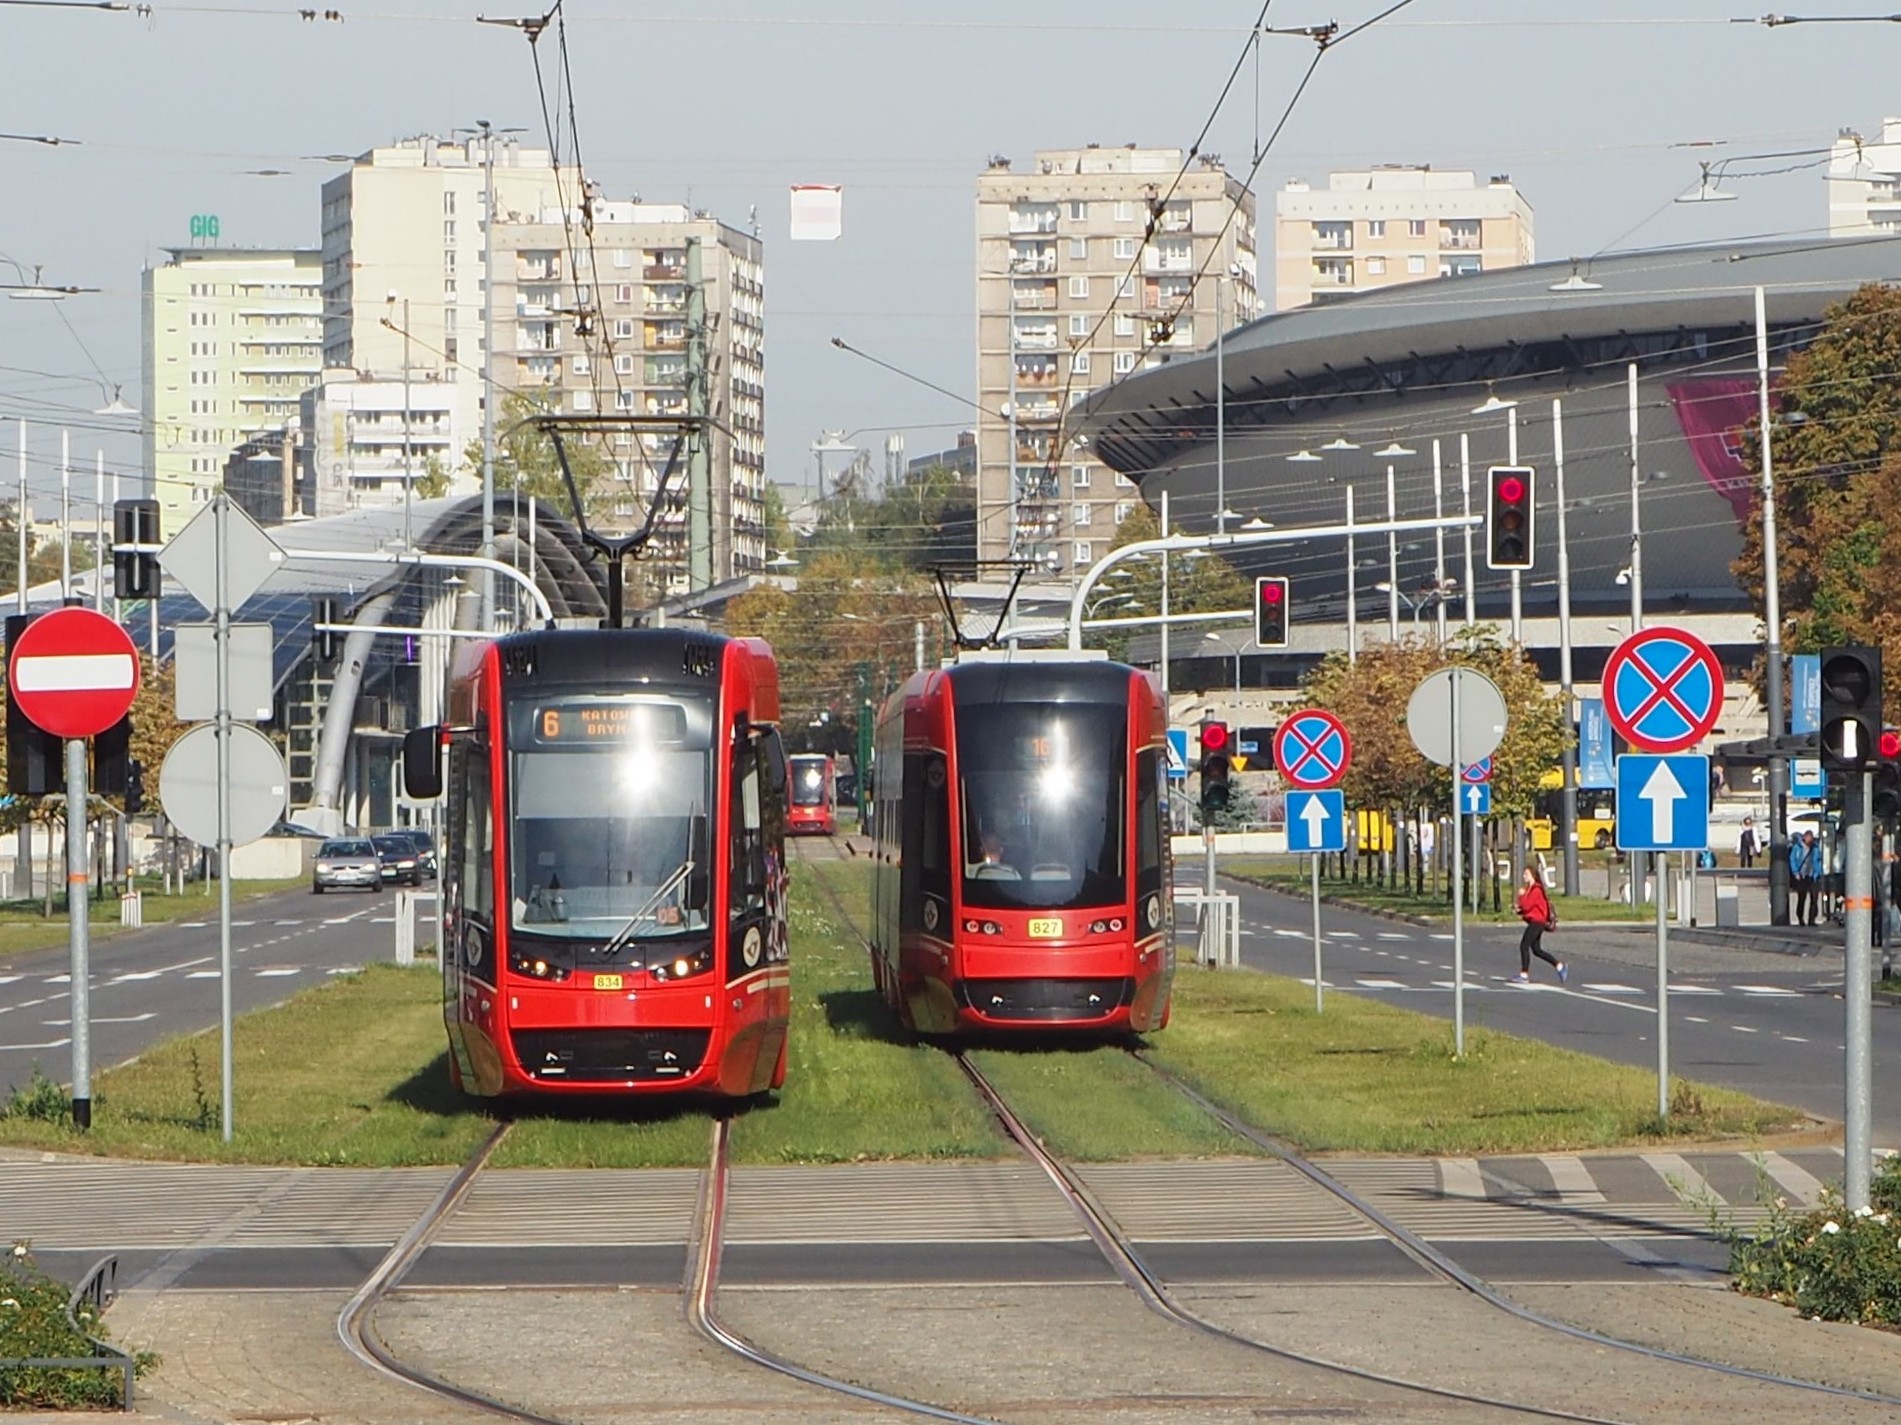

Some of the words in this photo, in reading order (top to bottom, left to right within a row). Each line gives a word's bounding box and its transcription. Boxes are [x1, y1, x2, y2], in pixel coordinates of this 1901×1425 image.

[190, 214, 220, 237] GIG
[543, 710, 560, 737] 6
[1033, 921, 1059, 934] 827
[597, 977, 619, 987] 834
